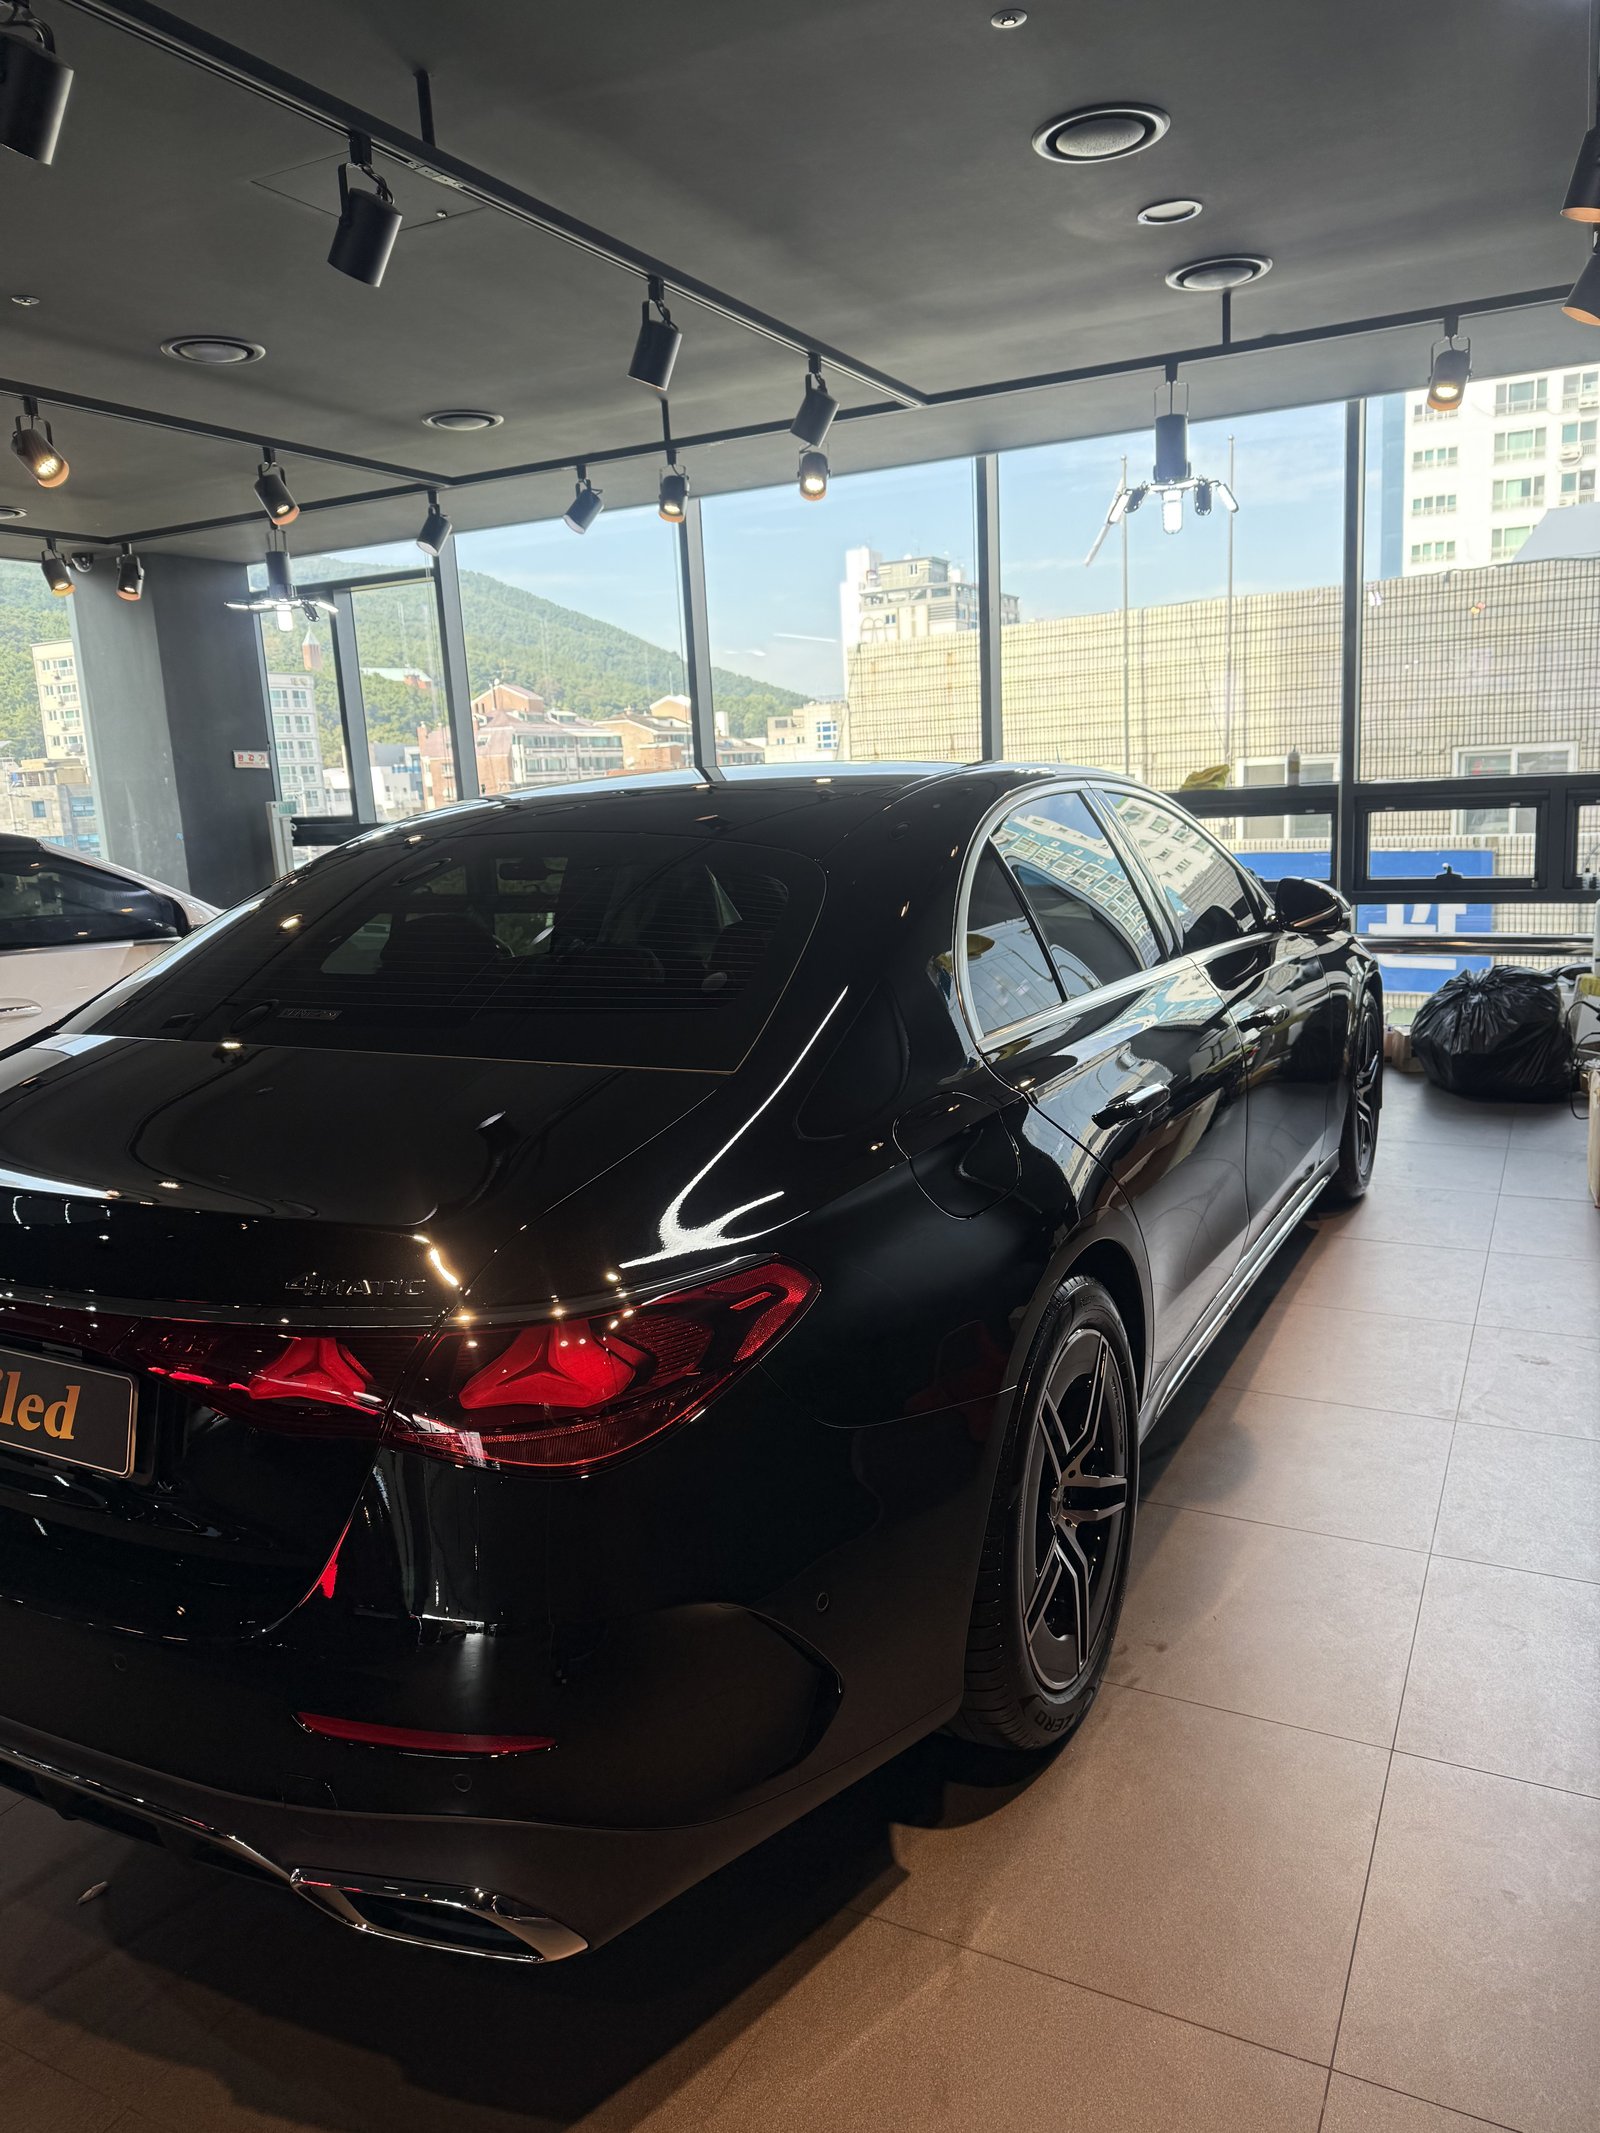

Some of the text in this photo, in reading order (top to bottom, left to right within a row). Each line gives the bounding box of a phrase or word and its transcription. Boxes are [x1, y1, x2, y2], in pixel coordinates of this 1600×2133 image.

[284, 1271, 427, 1295] 4MATIC
[0, 1369, 81, 1440] led
[1034, 1709, 1075, 1732] ZERO
